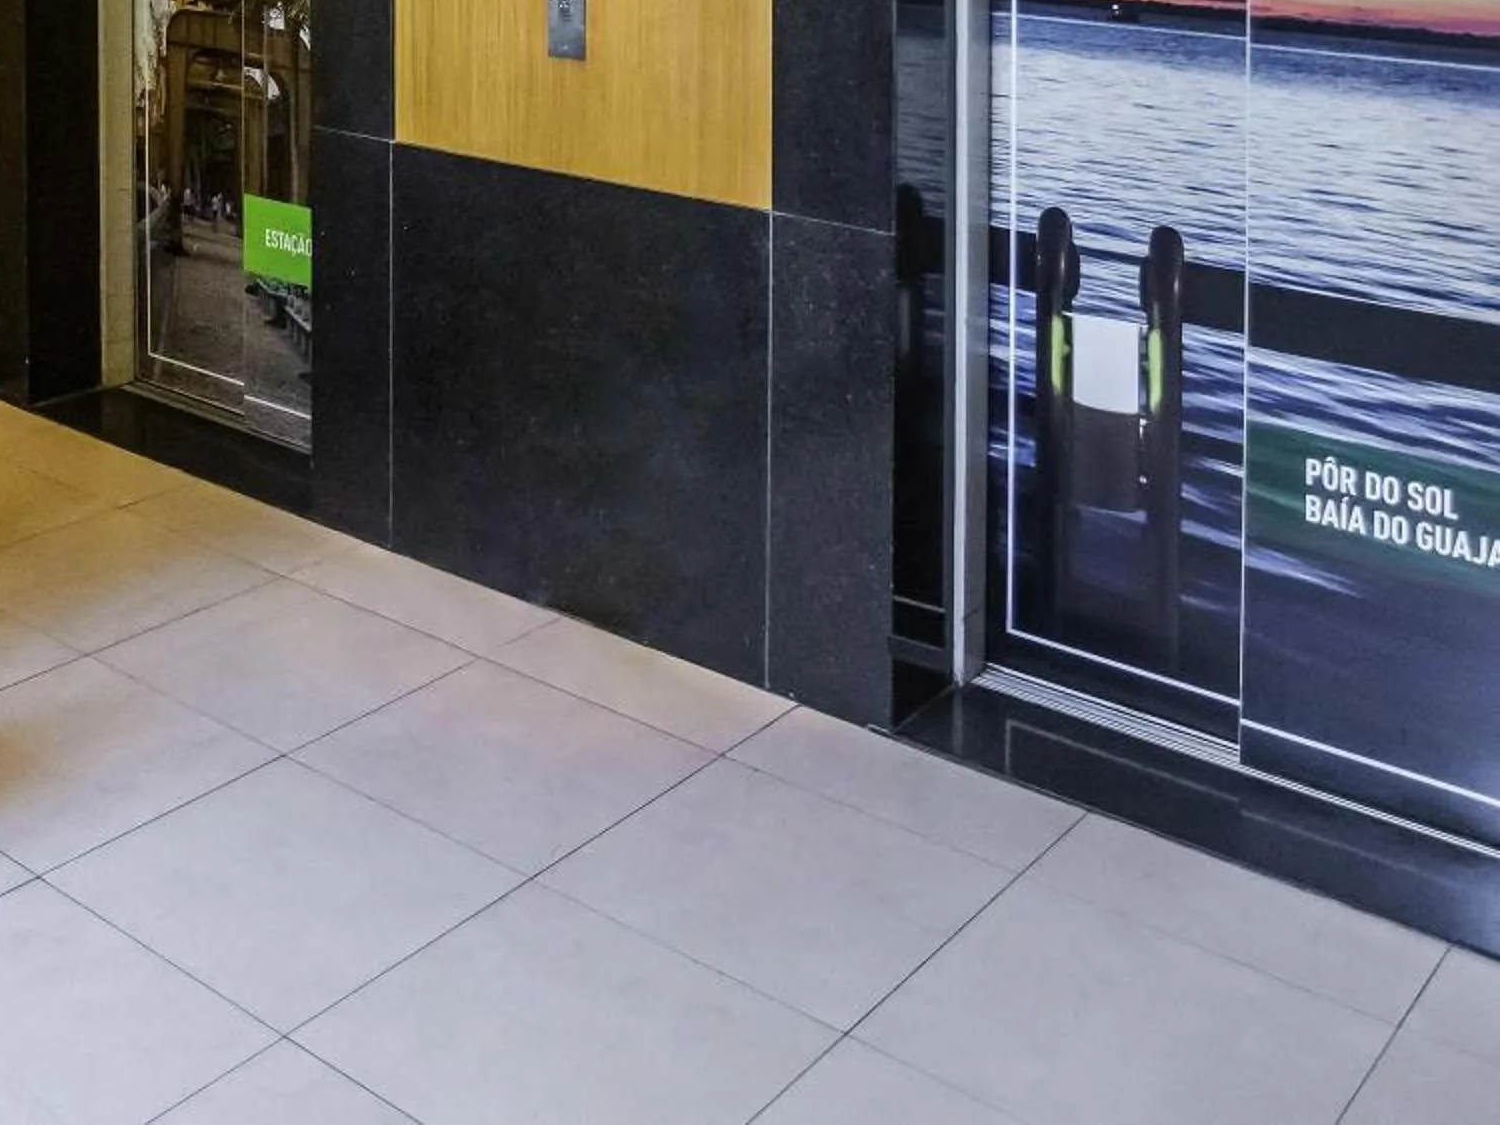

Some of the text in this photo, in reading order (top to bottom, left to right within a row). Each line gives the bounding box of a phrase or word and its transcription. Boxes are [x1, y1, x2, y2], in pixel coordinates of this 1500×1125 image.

[1305, 456, 1459, 521] PÔR DO SOL
[1304, 494, 1367, 536] BAÍA
[1373, 510, 1410, 545] DO
